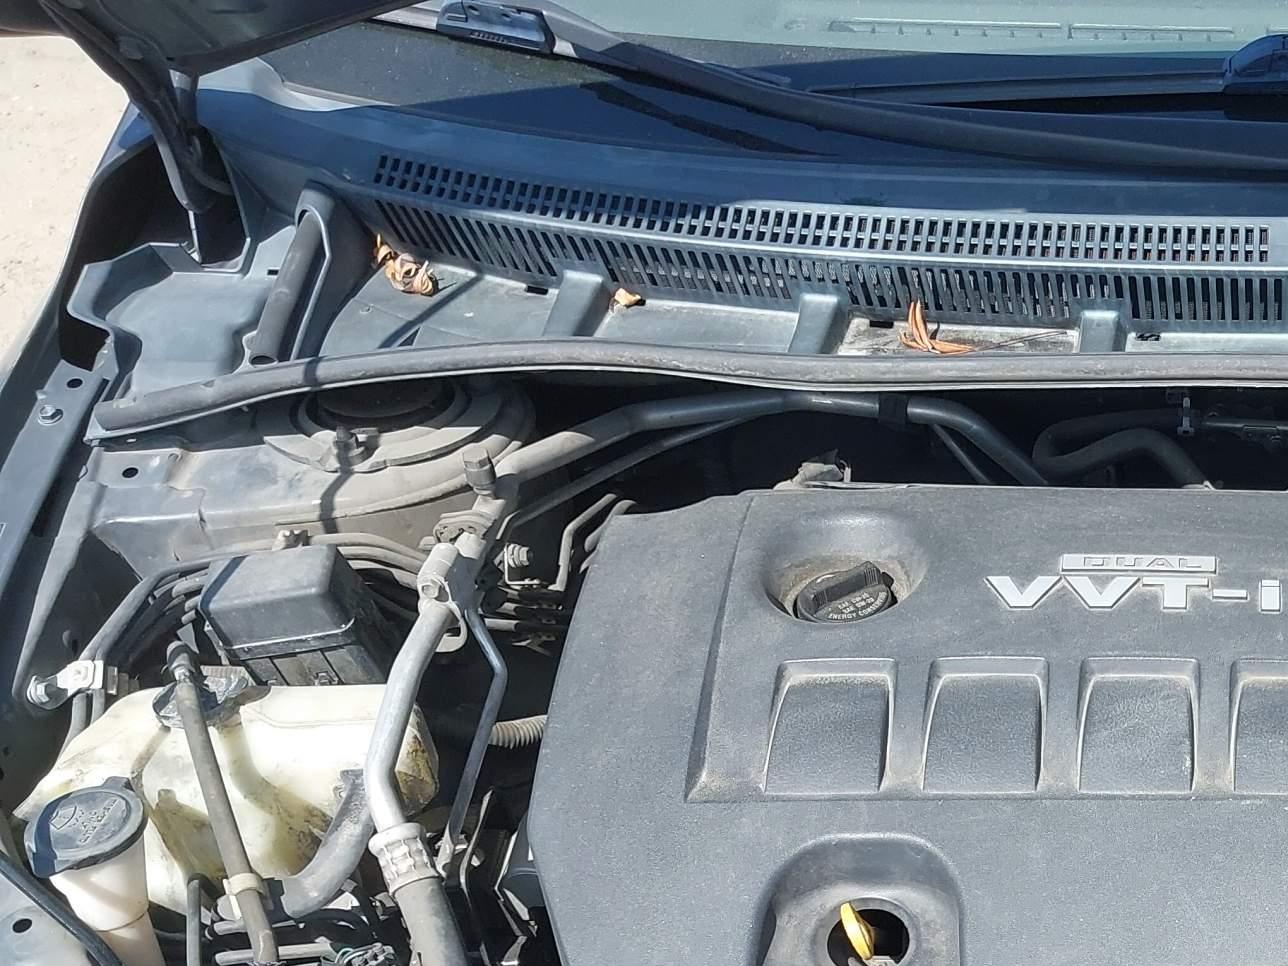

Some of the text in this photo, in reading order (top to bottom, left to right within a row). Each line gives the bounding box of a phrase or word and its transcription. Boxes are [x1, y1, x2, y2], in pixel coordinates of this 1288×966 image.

[1081, 556, 1204, 570] DUAL
[985, 576, 1282, 613] VVT-i
[828, 612, 857, 620] ENERGY
